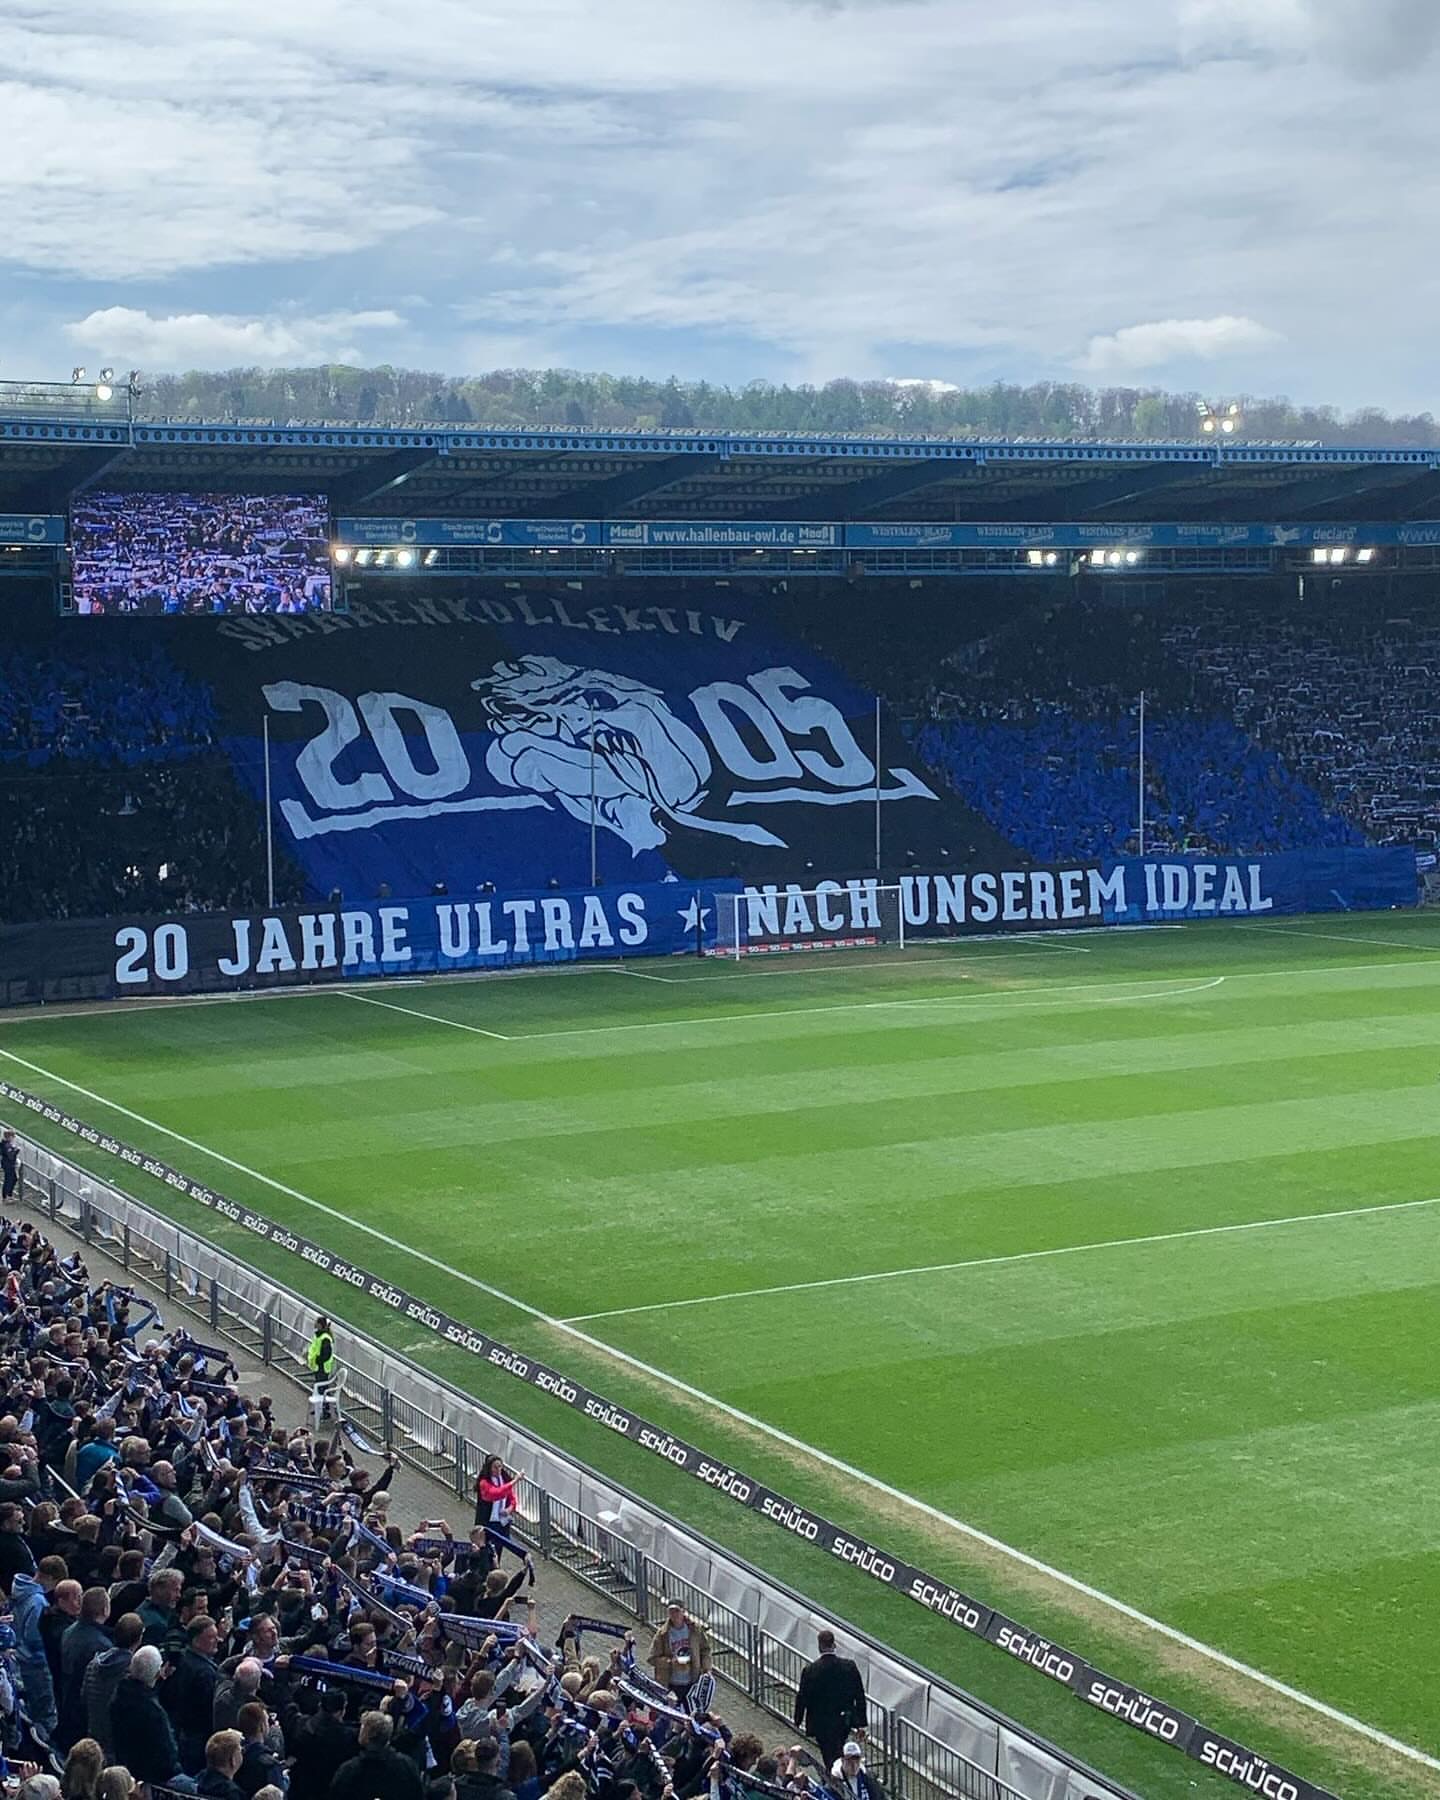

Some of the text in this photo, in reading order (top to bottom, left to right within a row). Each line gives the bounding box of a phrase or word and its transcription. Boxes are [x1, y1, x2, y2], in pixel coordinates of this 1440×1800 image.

[653, 528, 794, 543] www.hallenbau-owl.de
[262, 667, 876, 809] 20 05
[115, 863, 1273, 984] 20 JAHRE ULTRAS NACH UNSEREM IDEAL
[369, 1283, 402, 1308] SCHÜCO
[405, 1304, 441, 1330] SCHÜCO
[445, 1326, 482, 1353] SCHÜCO
[488, 1349, 528, 1377] SCHÜCO
[535, 1372, 577, 1403] SCHÜCO
[584, 1400, 629, 1433] SCHÜCO
[638, 1429, 688, 1465] SCHÜCO
[696, 1462, 751, 1501] SCHÜCO
[760, 1497, 819, 1540] SCHÜCO
[831, 1537, 895, 1582] SCHÜCO
[909, 1579, 981, 1630] SCHÜCO
[996, 1628, 1075, 1682] SCHÜCO
[1088, 1682, 1179, 1741] SCHÜCO
[1201, 1741, 1298, 1800] SCHÜCO
